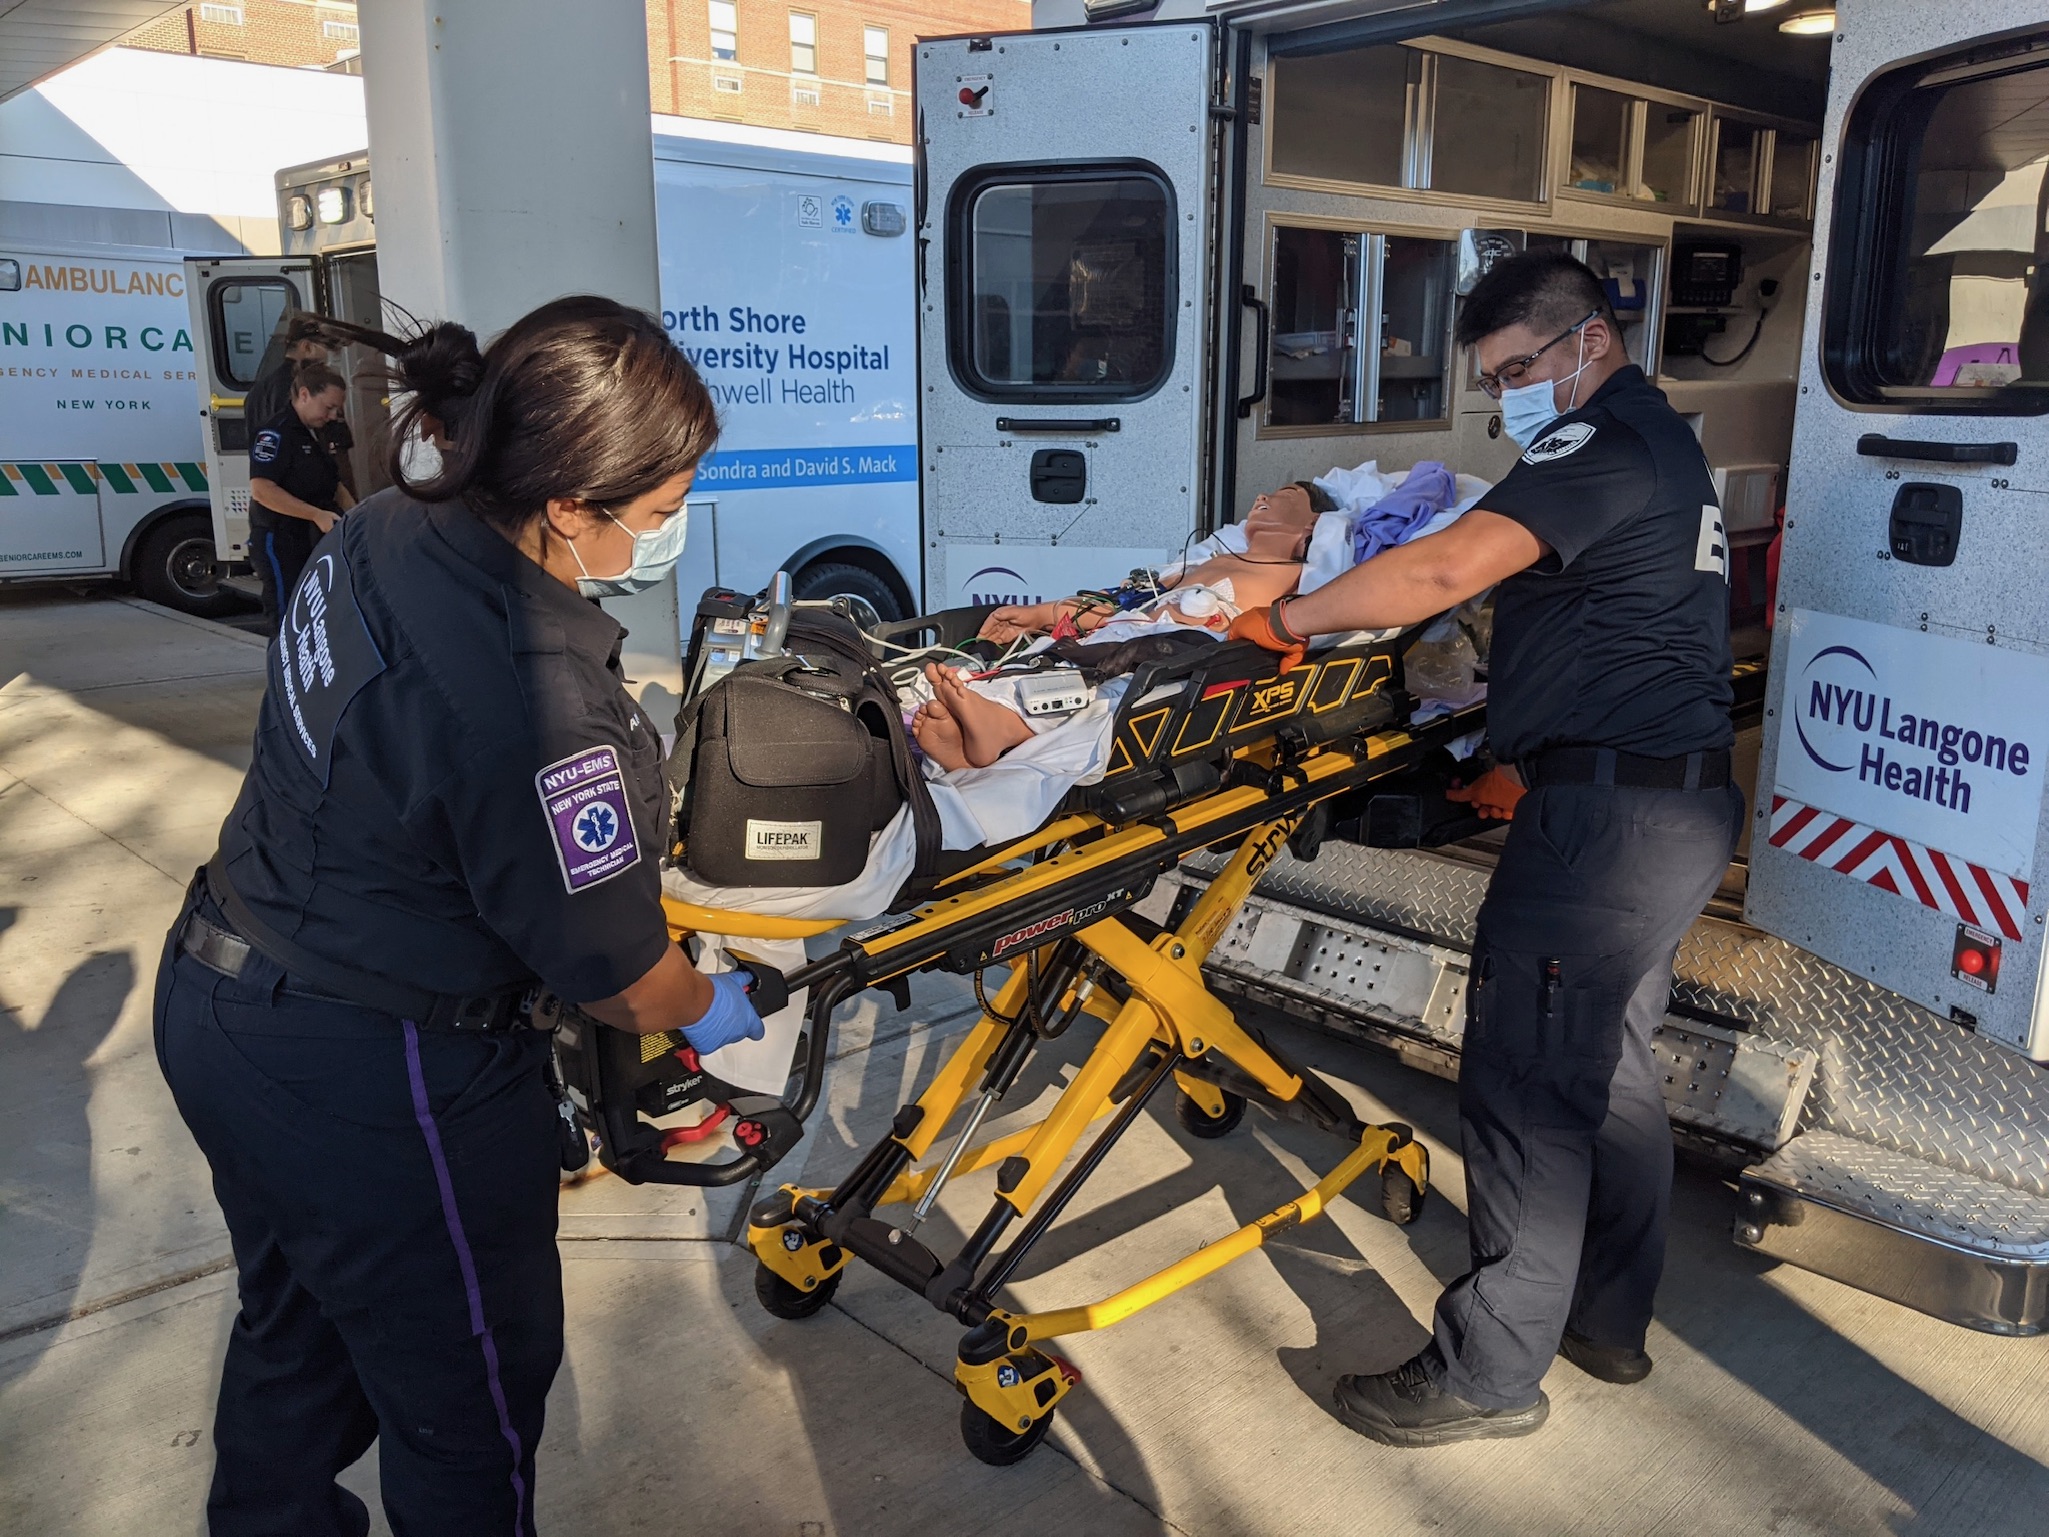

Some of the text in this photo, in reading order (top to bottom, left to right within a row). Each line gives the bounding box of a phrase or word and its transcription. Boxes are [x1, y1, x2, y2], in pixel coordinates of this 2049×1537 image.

[25, 265, 184, 297] AMBULANC
[662, 305, 806, 334] orth Shore
[71, 368, 152, 380] MEDICAL
[163, 370, 197, 380] SER
[788, 344, 890, 374] Hospital
[57, 399, 152, 410] NEW YORK
[705, 378, 855, 404] hwell Health
[698, 455, 897, 481] Sondra and David S. Mack
[303, 569, 336, 688] NYU Langone
[296, 622, 317, 693] Health
[1251, 681, 1295, 711] XPS
[292, 704, 317, 759] SERVICES
[1809, 680, 2030, 776] NYU Langone
[543, 755, 613, 790] NYU-EMS
[1859, 742, 1972, 814] Health
[551, 780, 621, 816] NEW YORK STATE
[757, 831, 808, 845] LIFEPAK
[1246, 814, 1299, 876] stry
[1965, 928, 1993, 945] EMERGENCY
[666, 1075, 703, 1096] stryker
